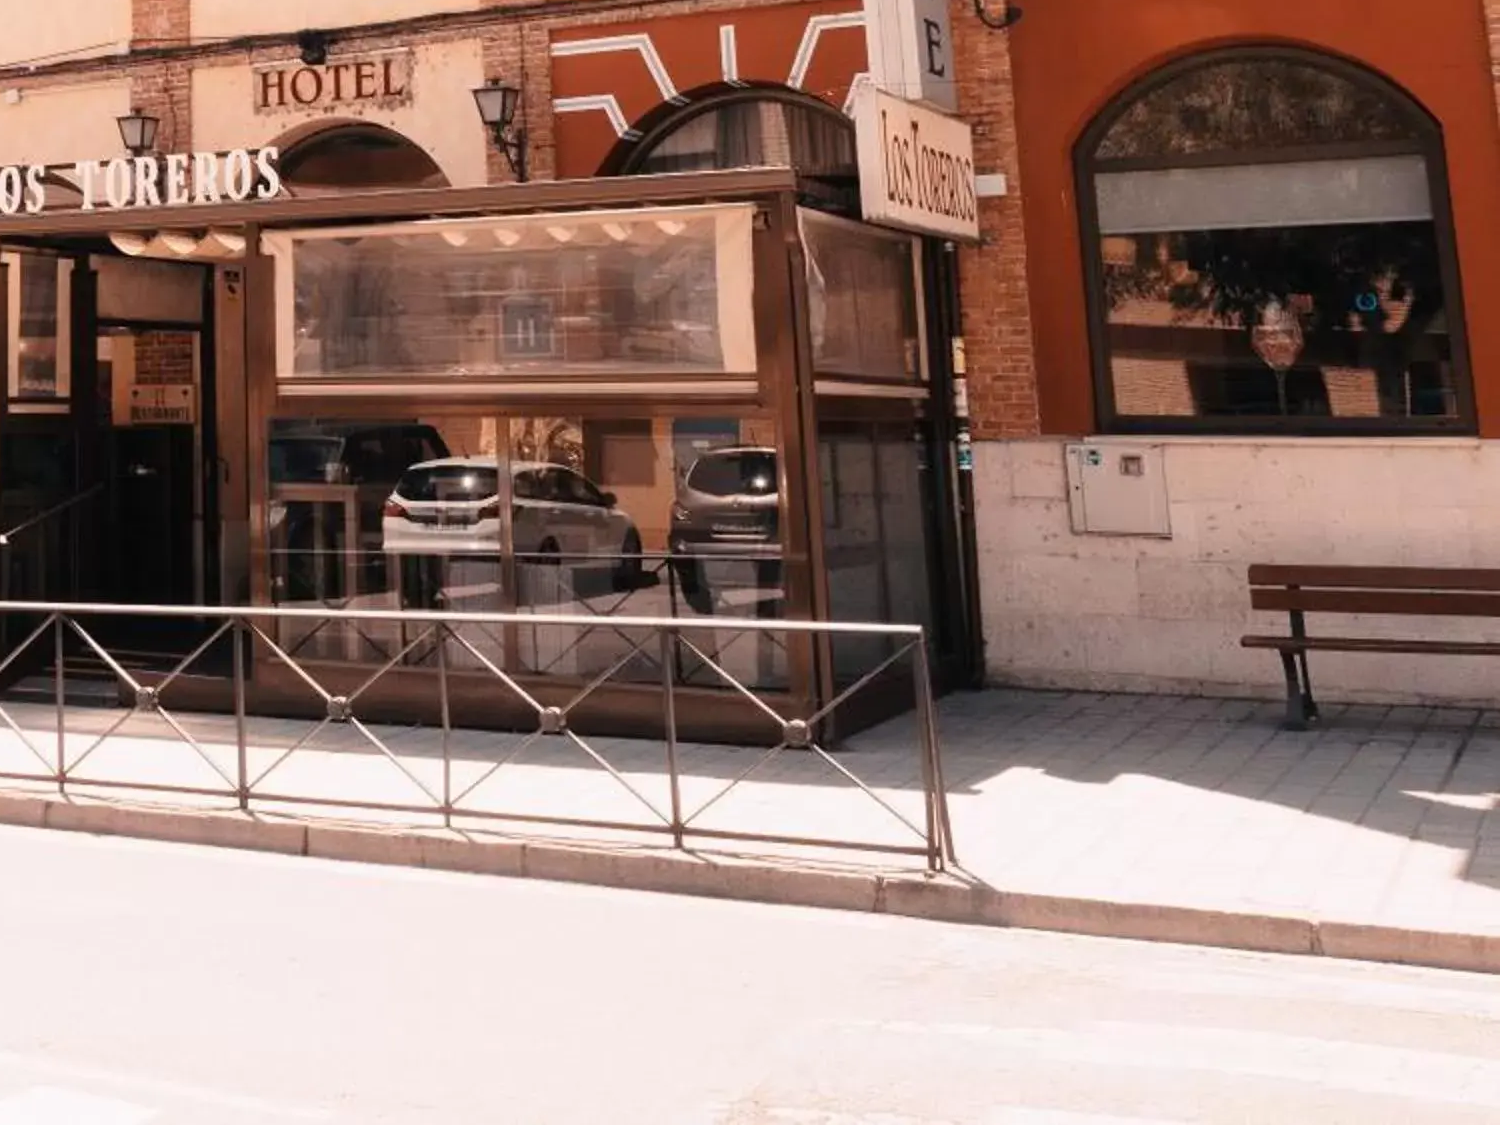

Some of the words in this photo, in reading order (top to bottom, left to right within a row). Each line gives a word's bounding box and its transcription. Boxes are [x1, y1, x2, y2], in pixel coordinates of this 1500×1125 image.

[259, 59, 406, 108] HOTEL
[76, 146, 281, 212] TOREROS
[881, 109, 913, 209] LOS
[910, 120, 975, 223] TOREROS
